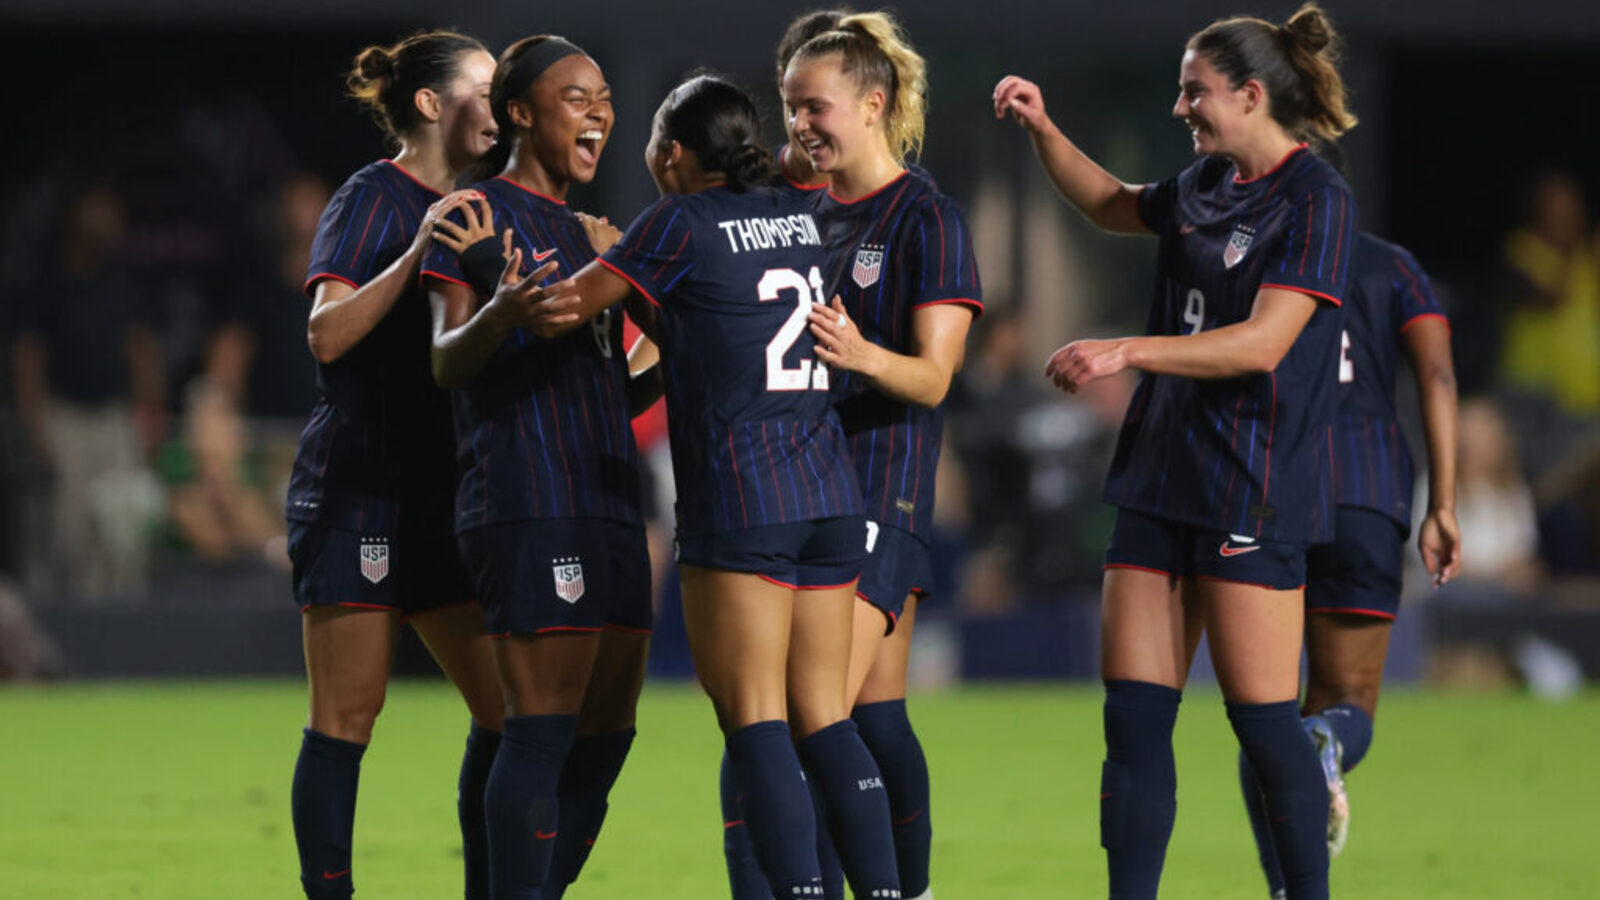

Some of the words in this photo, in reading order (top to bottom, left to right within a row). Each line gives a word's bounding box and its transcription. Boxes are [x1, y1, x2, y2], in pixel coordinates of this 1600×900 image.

[718, 213, 821, 253] THOMPSON
[858, 252, 881, 267] USA
[1184, 288, 1205, 335] 9
[757, 265, 829, 391] 21
[362, 546, 387, 561] USA
[858, 777, 883, 790] USA
